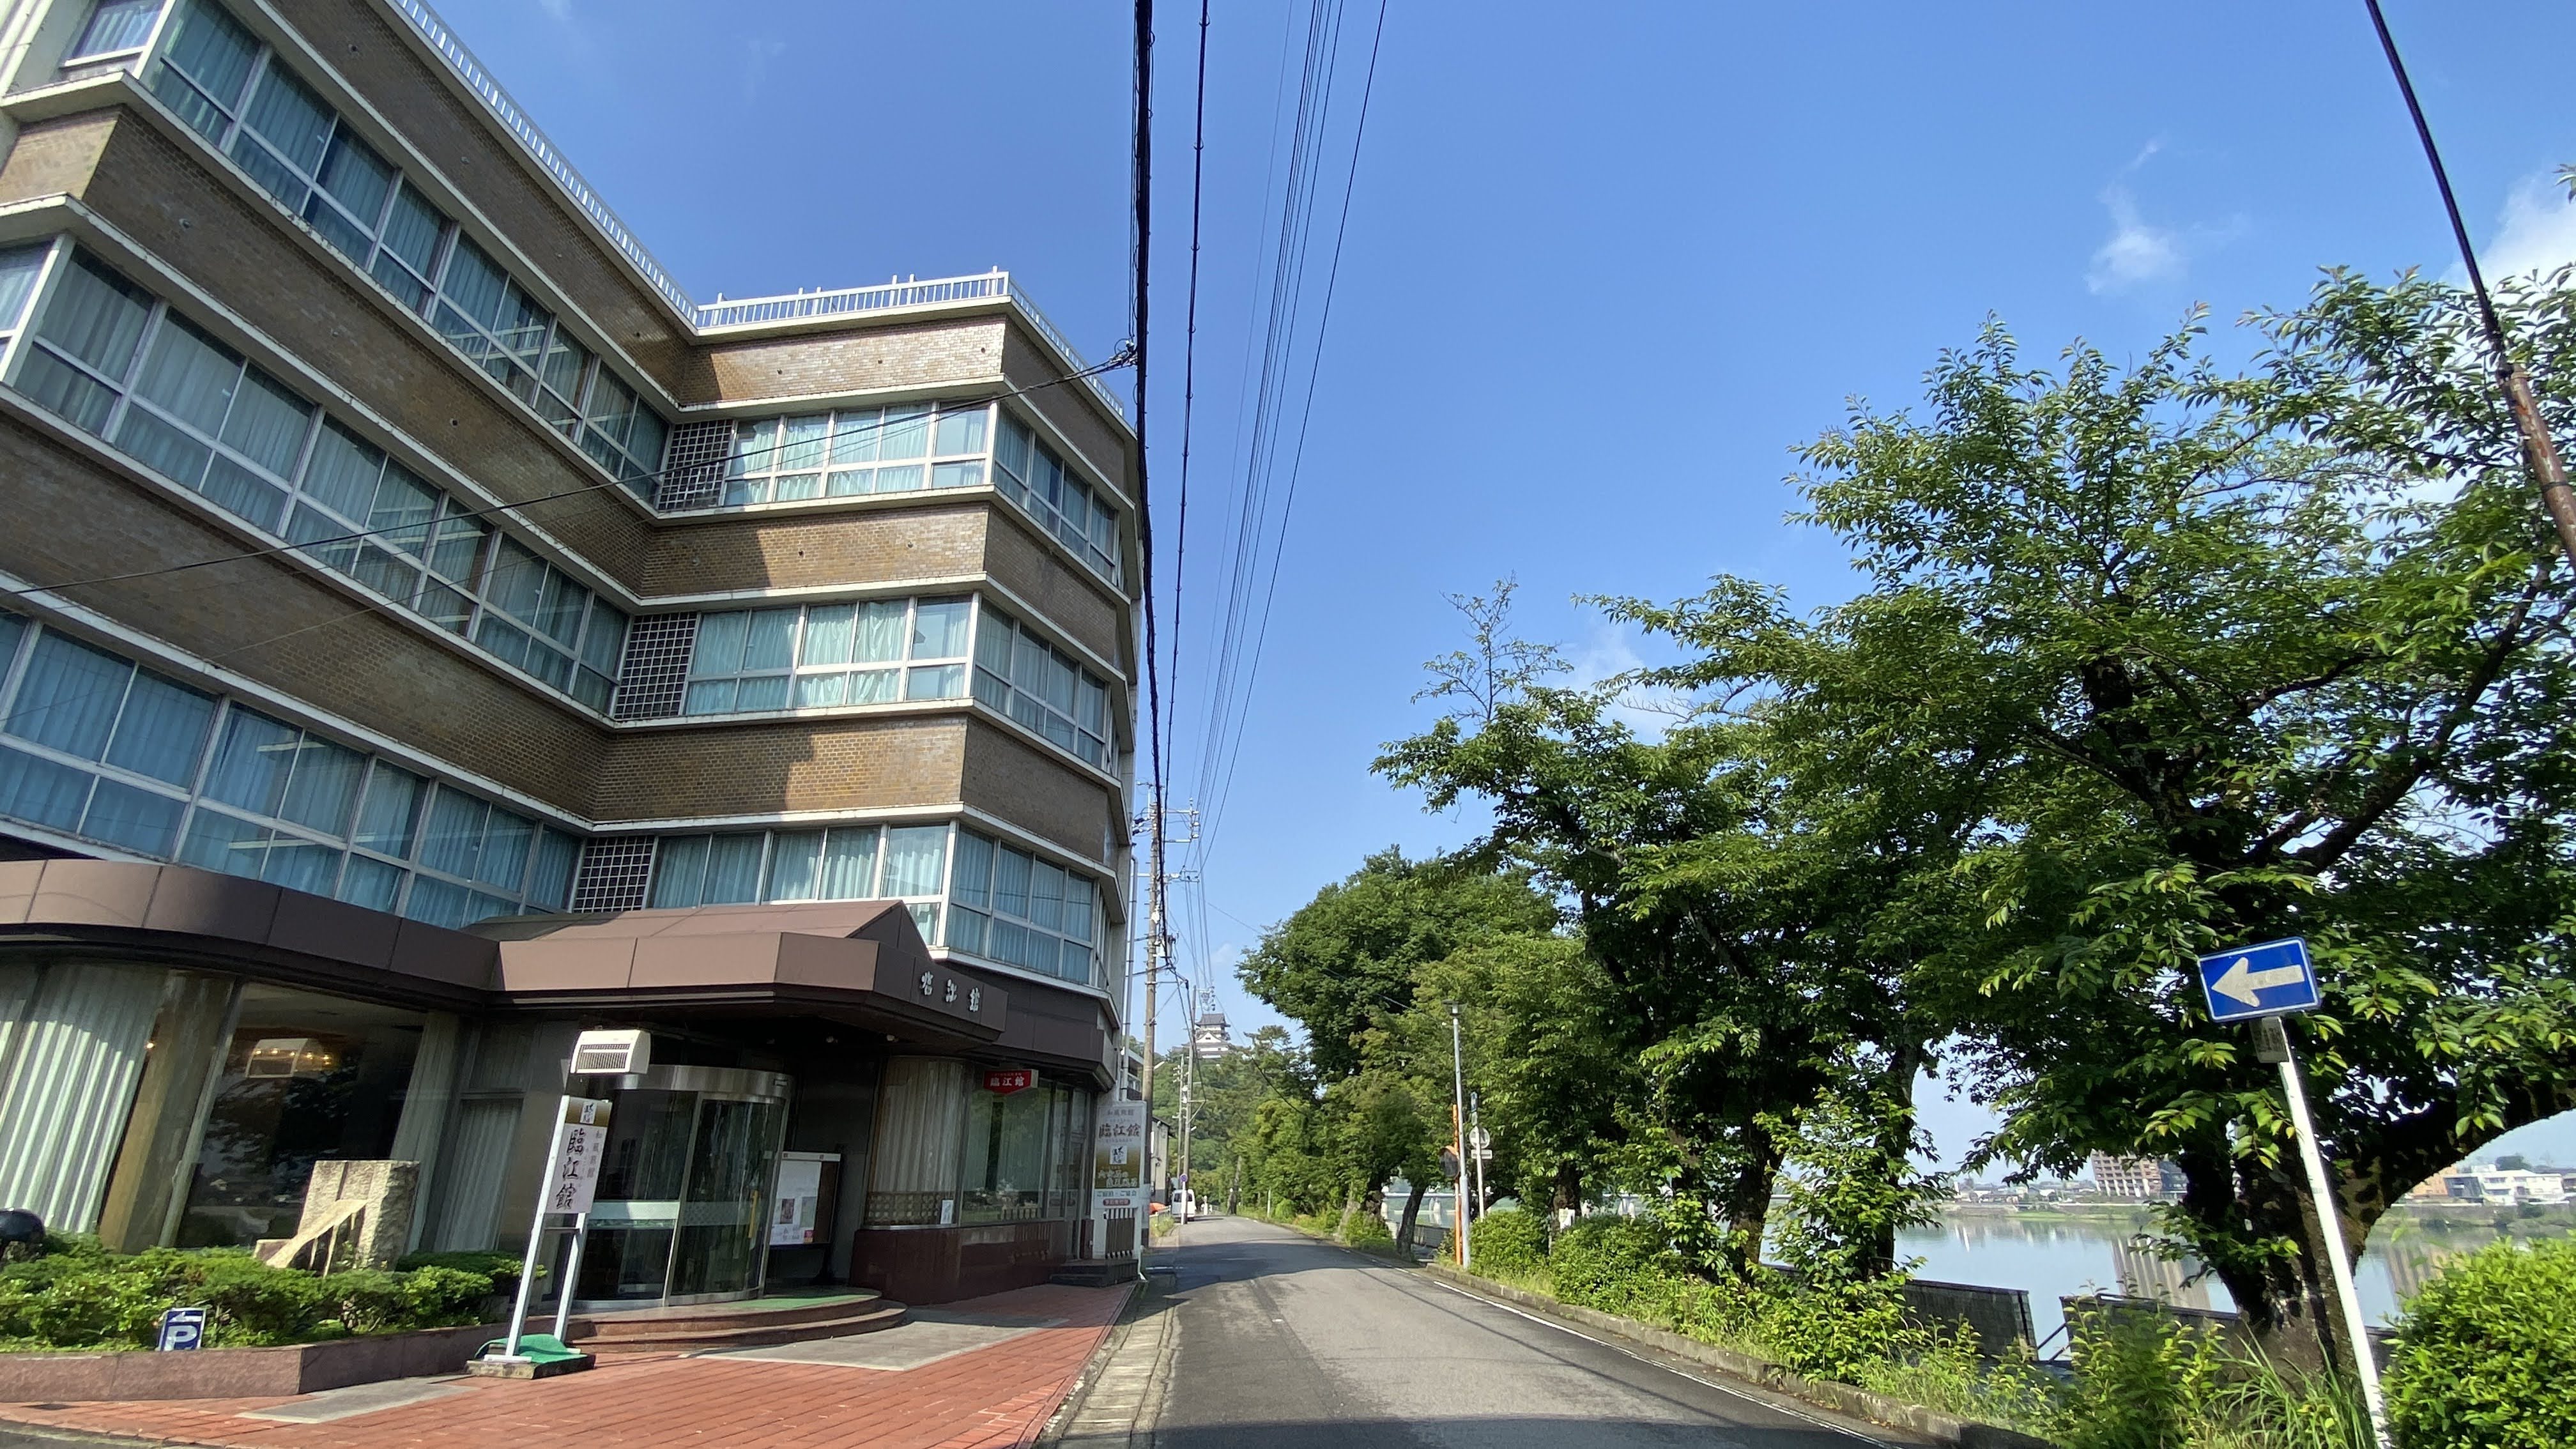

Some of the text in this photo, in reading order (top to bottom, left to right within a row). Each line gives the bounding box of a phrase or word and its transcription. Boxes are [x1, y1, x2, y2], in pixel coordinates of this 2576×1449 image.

[1099, 1123, 1141, 1138] 臨江館
[556, 1128, 586, 1210] 臨江館
[164, 1325, 197, 1351] P
